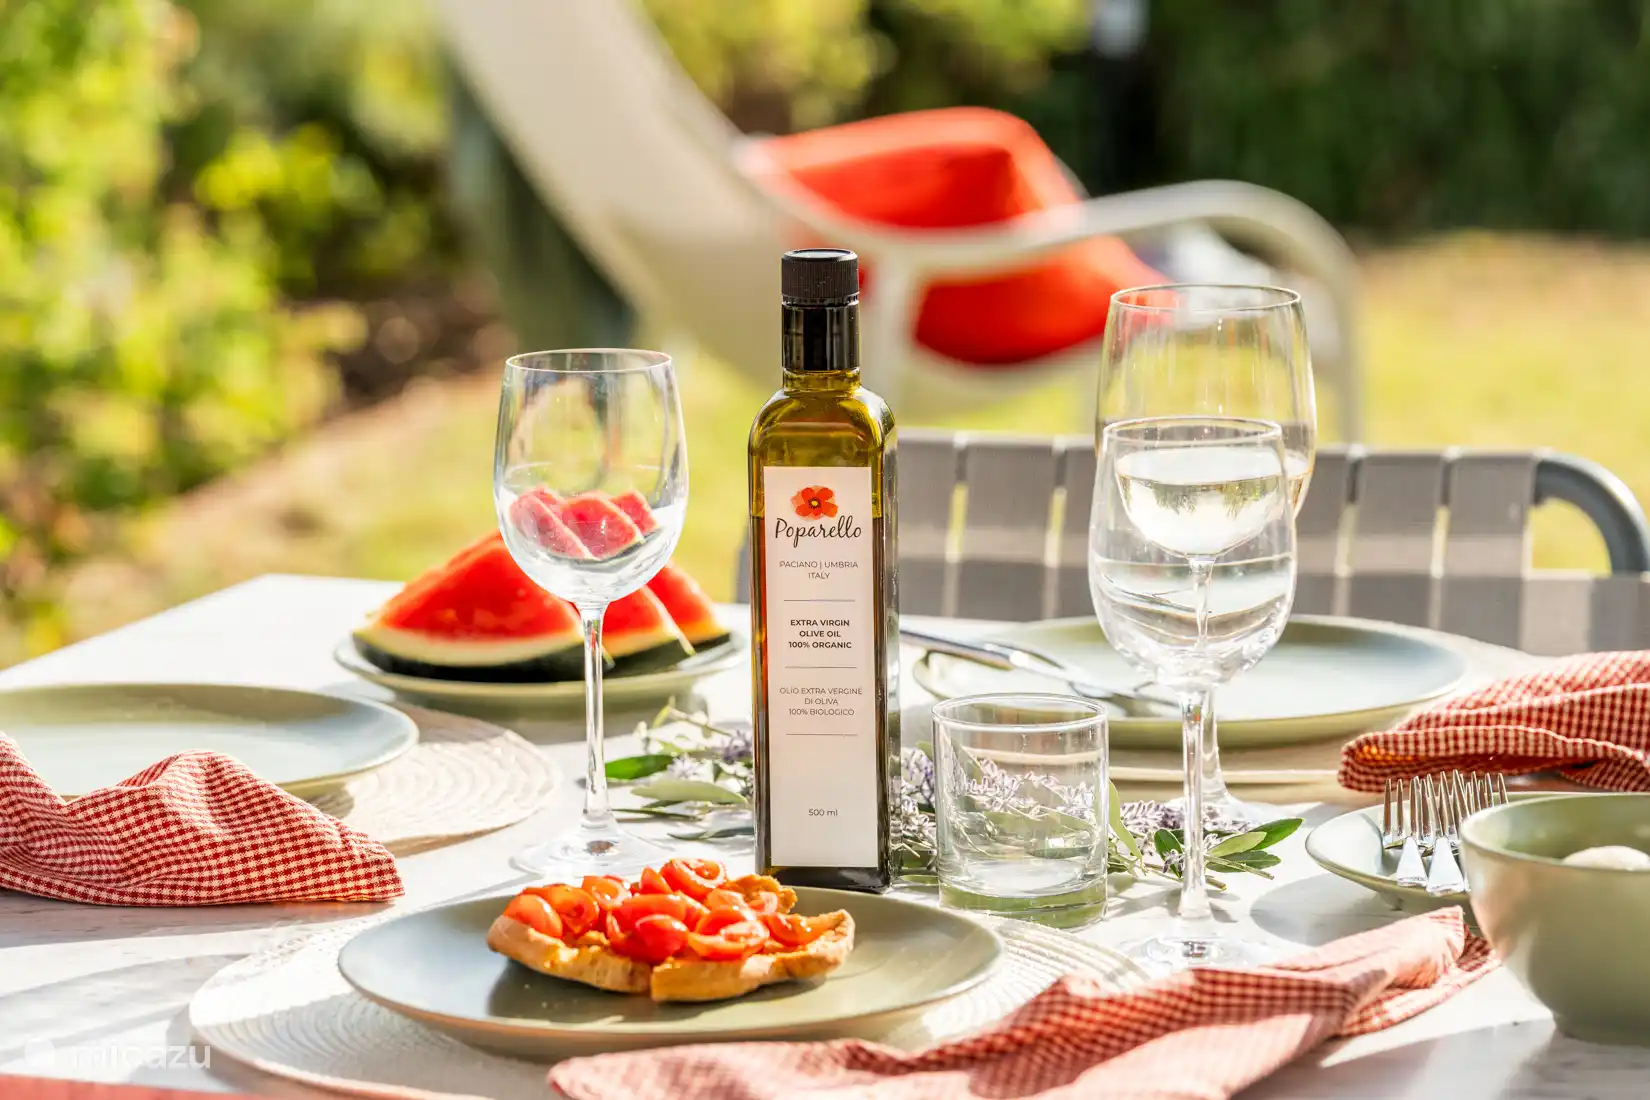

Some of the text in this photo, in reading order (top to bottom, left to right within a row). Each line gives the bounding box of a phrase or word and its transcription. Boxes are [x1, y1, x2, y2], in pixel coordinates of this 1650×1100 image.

[775, 515, 862, 548] Poparello
[780, 560, 818, 568] PACIANO
[812, 641, 852, 649] ORGANIC
[828, 687, 862, 695] VERGINE
